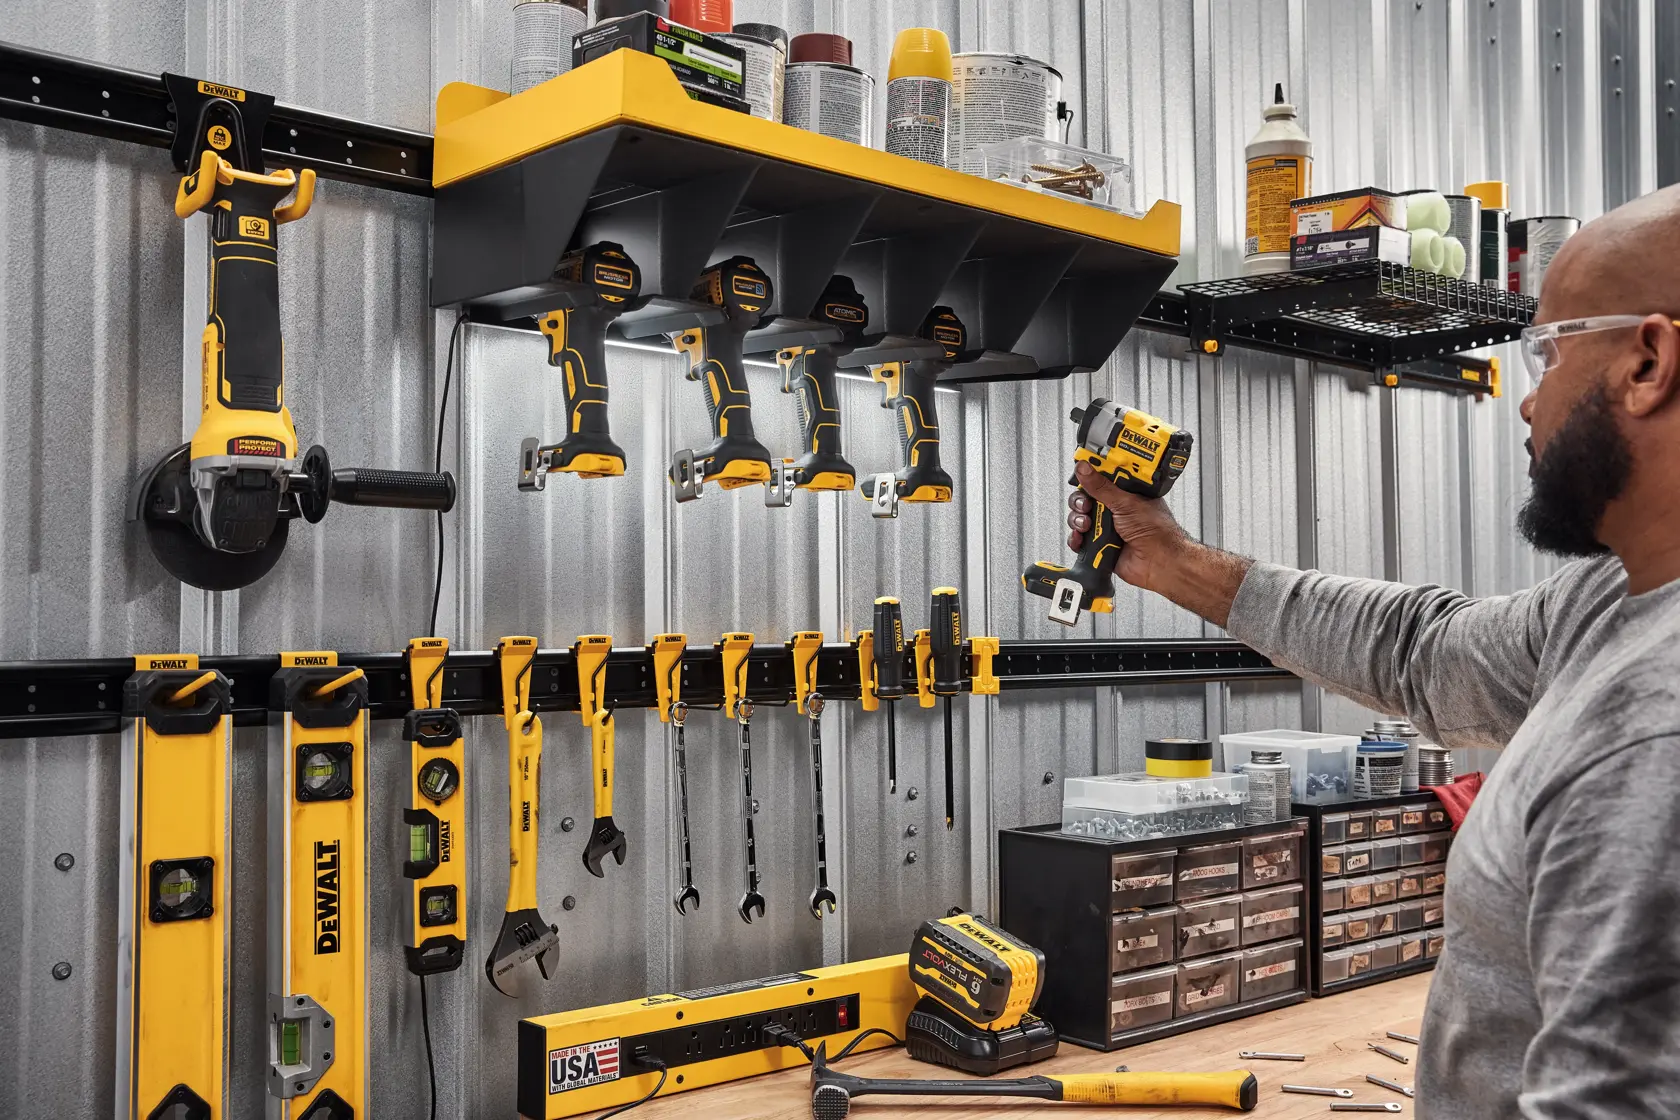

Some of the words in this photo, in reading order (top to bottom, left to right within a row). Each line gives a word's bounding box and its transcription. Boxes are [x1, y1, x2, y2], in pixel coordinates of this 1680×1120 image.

[672, 26, 689, 37] FINISH
[689, 31, 703, 42] NAILS
[203, 83, 240, 99] DEWALT
[1557, 321, 1587, 332] DEWALT
[1121, 429, 1160, 452] DEWALT
[895, 620, 903, 651] DEWALT
[150, 660, 188, 670] DEWALT
[294, 656, 328, 666] DEWALT
[440, 820, 450, 862] DEWALT
[315, 840, 340, 955] DEWALT
[959, 923, 1012, 952] DEWALT
[922, 949, 968, 982] FLEXVOLT
[970, 981, 981, 995] 6
[552, 1049, 569, 1060] MADE
[570, 1048, 576, 1056] IN
[579, 1045, 590, 1055] THE
[552, 1051, 599, 1085] USA
[552, 1082, 566, 1092] WITH
[567, 1078, 586, 1089] GLOBAL
[588, 1073, 616, 1084] MATERIALS
